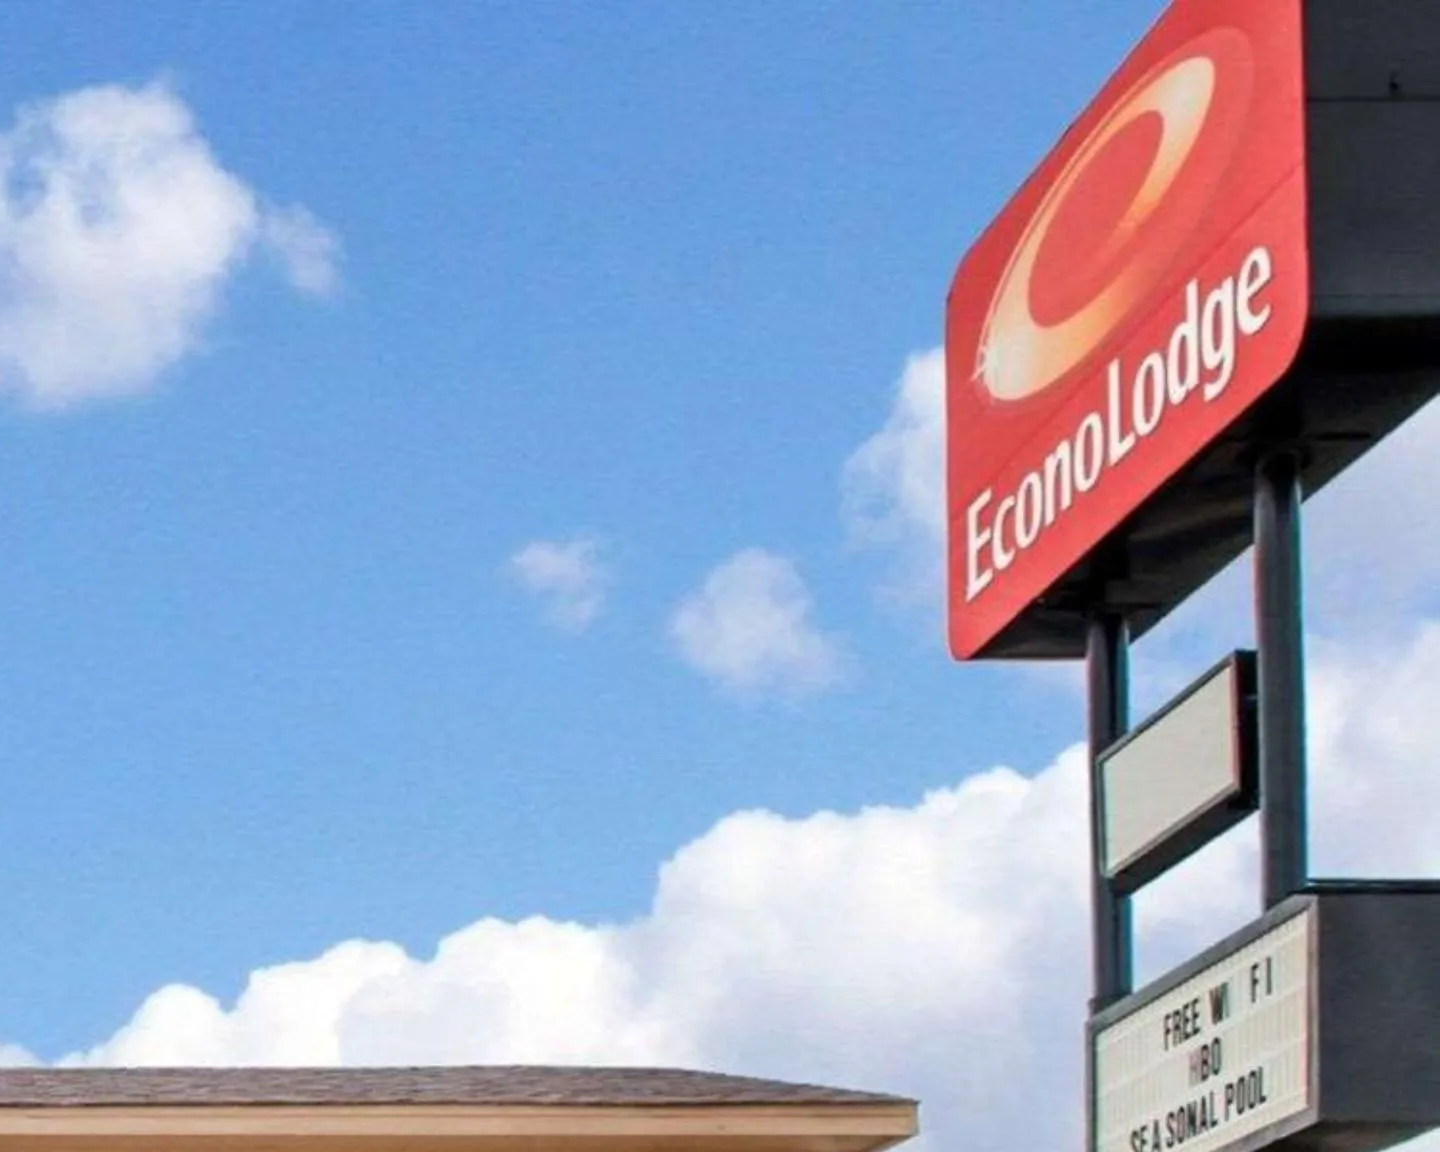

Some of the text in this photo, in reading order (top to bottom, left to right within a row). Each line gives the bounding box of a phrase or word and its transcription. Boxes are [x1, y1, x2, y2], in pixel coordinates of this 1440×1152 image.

[965, 245, 1272, 602] EconoLodge
[1163, 997, 1201, 1051] FREE
[1224, 1065, 1267, 1121] POOL
